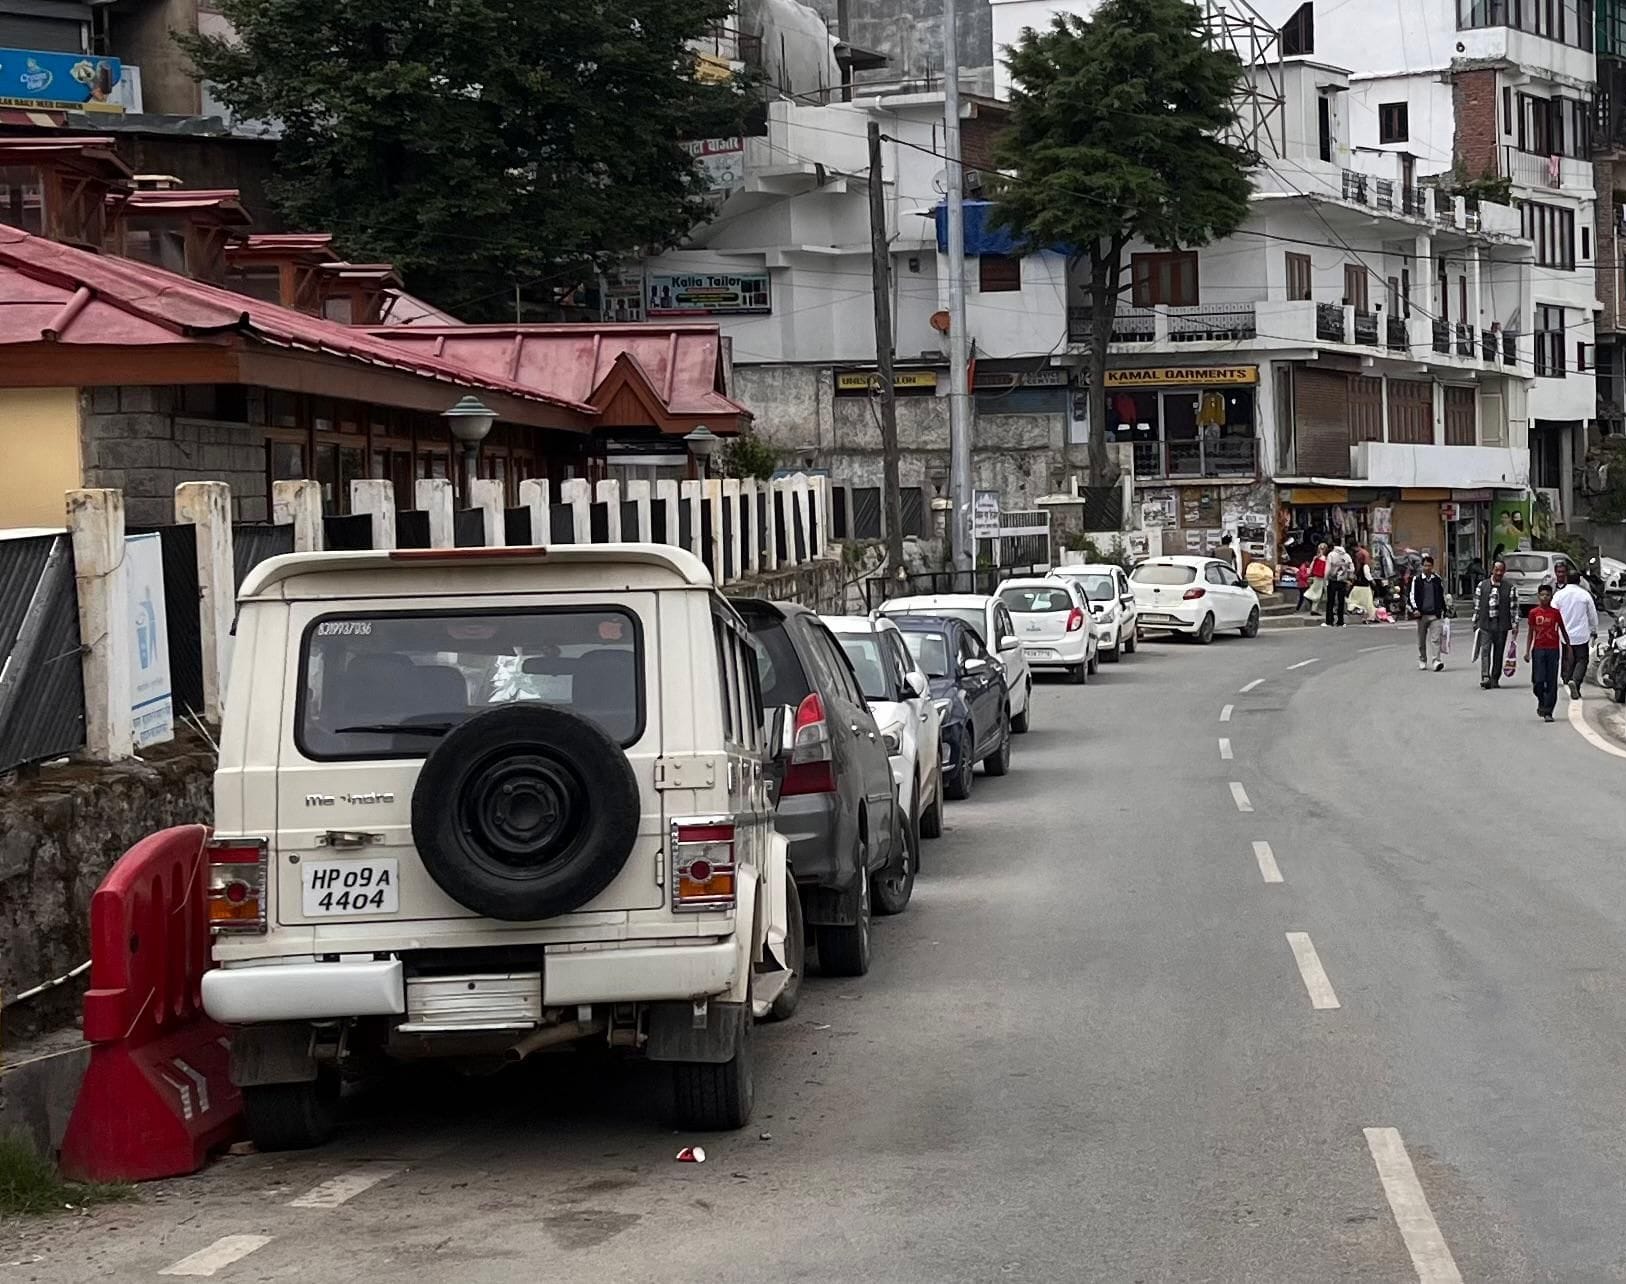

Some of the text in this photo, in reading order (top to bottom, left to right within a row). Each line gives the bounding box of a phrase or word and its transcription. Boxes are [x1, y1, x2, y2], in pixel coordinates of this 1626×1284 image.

[706, 275, 742, 287] Tailor
[1108, 370, 1160, 381] KAMAL
[318, 889, 385, 912] 4404
